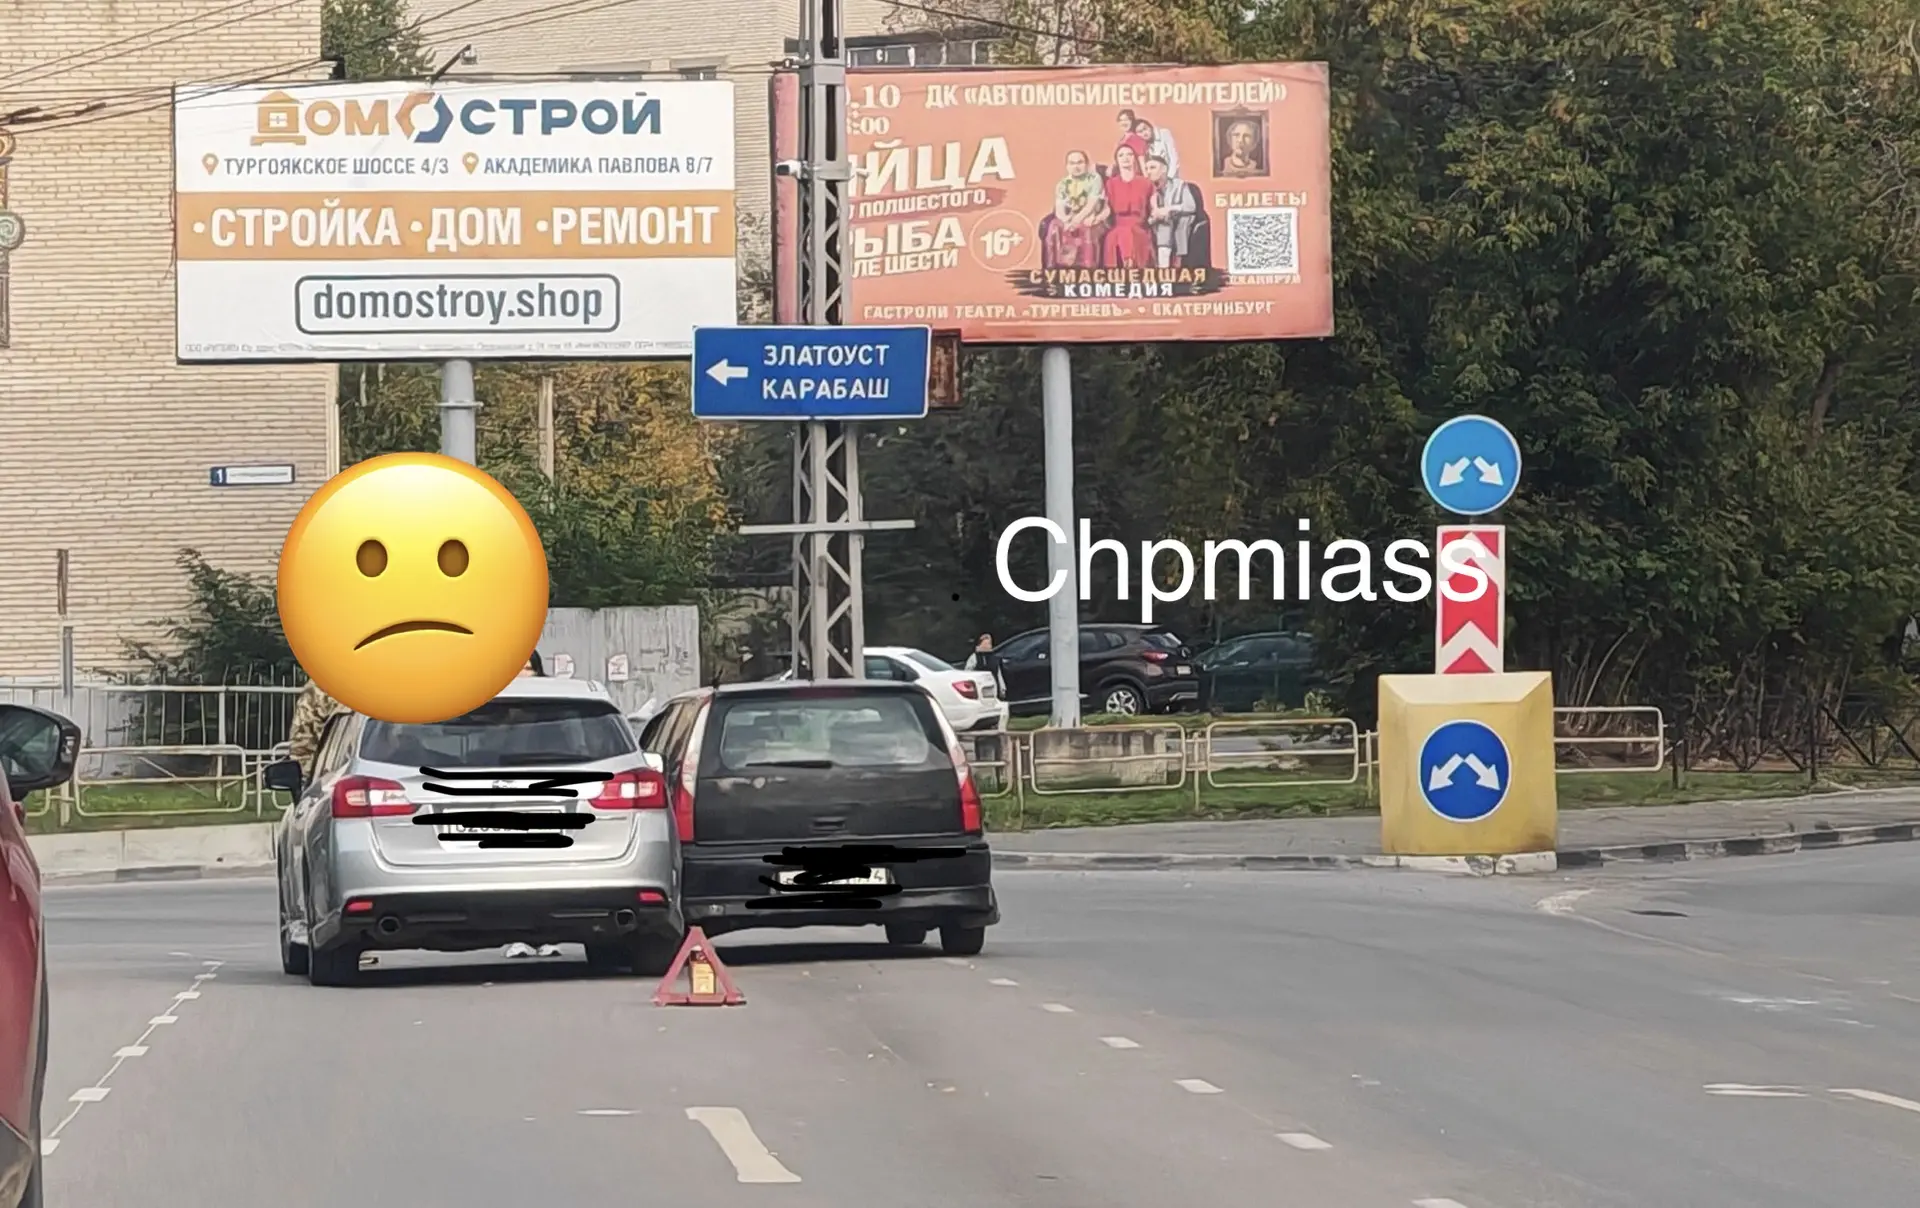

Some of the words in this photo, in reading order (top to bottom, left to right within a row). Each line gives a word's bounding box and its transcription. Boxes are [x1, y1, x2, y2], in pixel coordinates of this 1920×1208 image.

[846, 84, 901, 109] .10
[925, 84, 958, 109] ДК
[965, 78, 1287, 107] «АВТОМОБИЛЕСТРОИТЕЛЕЙ»
[224, 157, 348, 175] ТУРГОЯКСКОЕ
[352, 157, 415, 175] ШОССЕ
[420, 157, 449, 175] 4/3
[483, 157, 592, 176] АКАДЕМИКА
[598, 156, 680, 174] ПАВЛОВА
[686, 156, 713, 175] 8/7
[1215, 192, 1307, 207] БИЛЕТЫ
[211, 198, 401, 247] СТРОЙКА
[426, 206, 521, 252] ДОМ
[551, 205, 720, 246] РЕМОНТ
[849, 217, 967, 258] ЫБА
[980, 228, 1024, 258] 16+
[884, 249, 959, 275] ШЕСТИ
[1029, 268, 1206, 284] СУМАСШЕДШАЯ
[1064, 283, 1173, 299] КОМЕДИЯ
[313, 283, 602, 326] domostroy.shop
[863, 304, 948, 319] ГАСТРОЛИ
[955, 304, 1016, 319] ТЕАТРА
[763, 344, 890, 367] ЗЛАТОУСТ
[762, 377, 889, 400] КАРАБАШ
